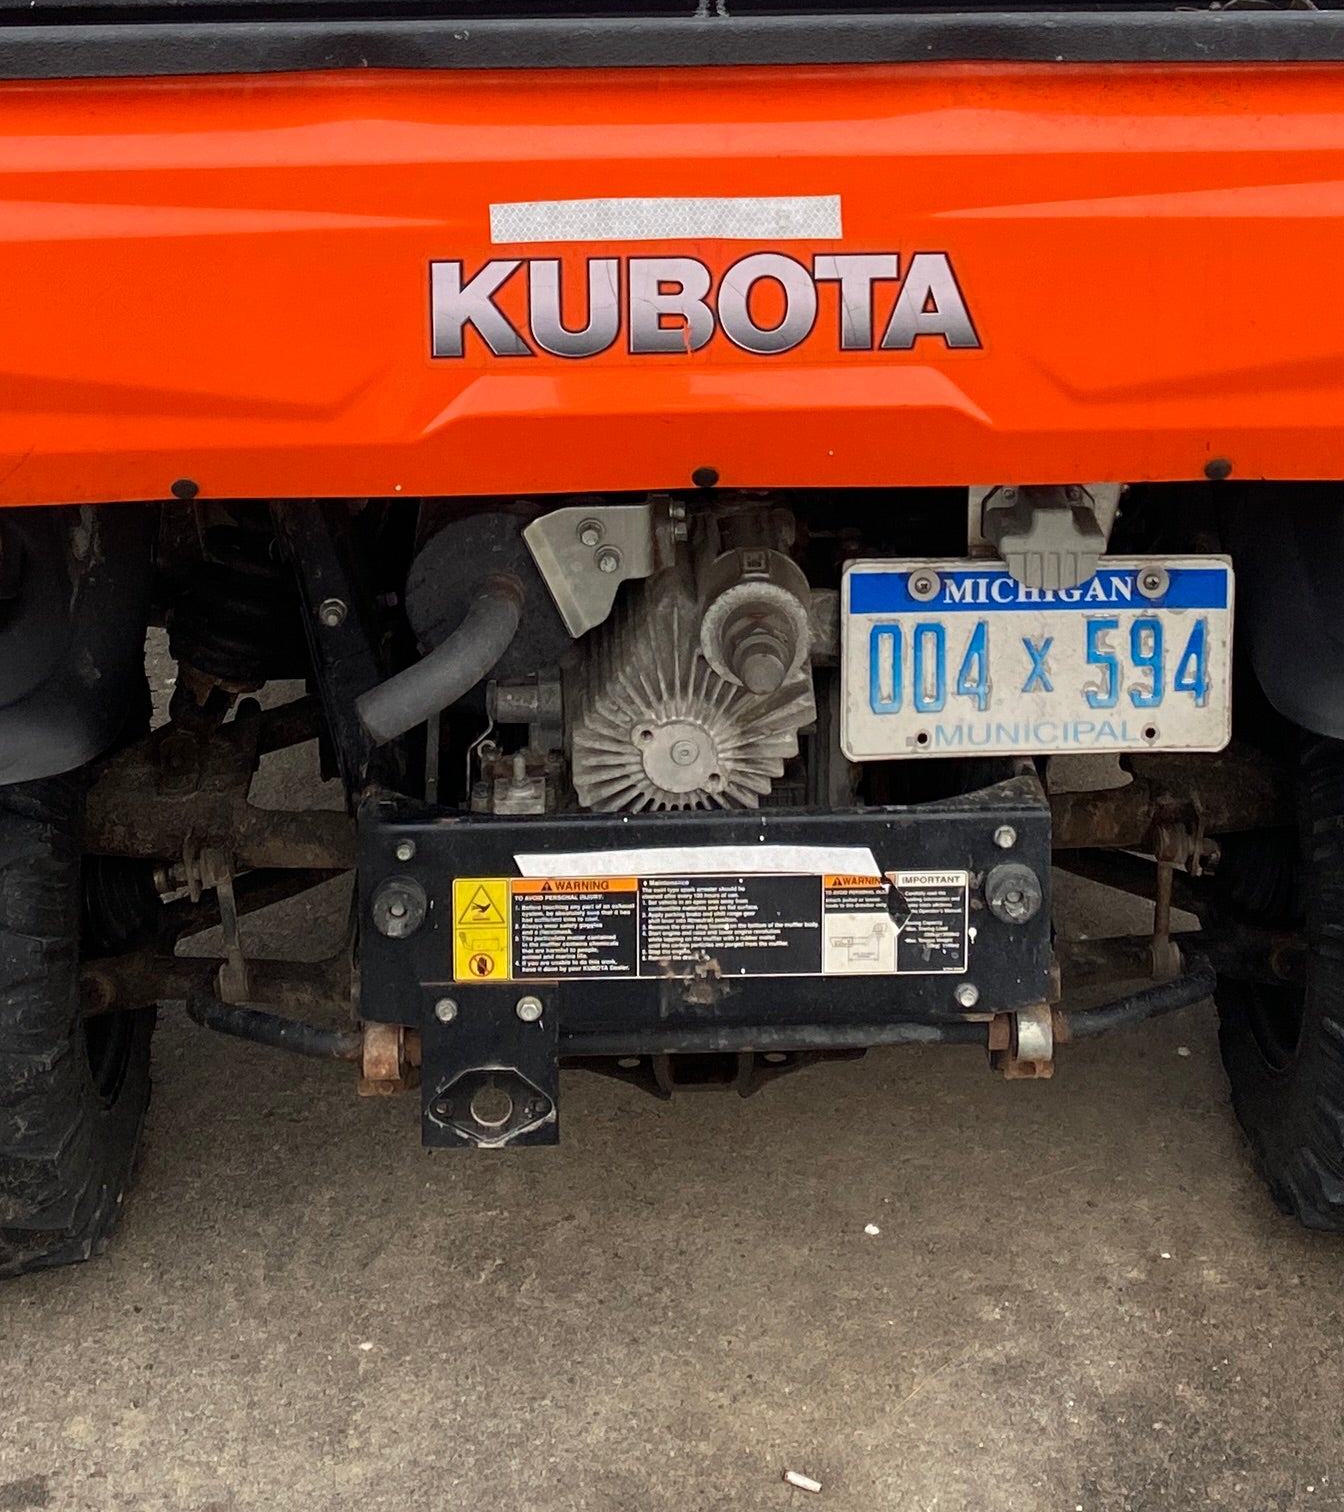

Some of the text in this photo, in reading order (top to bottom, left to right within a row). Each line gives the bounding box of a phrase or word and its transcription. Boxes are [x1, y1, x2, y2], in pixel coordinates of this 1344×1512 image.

[429, 251, 984, 359] KUBOTA
[868, 616, 1210, 714] 004 X 594
[935, 720, 1140, 747] MUNICIPAL
[555, 880, 609, 891] WARNING
[842, 876, 882, 887] WARNIN
[902, 876, 961, 884] IMPORTANT
